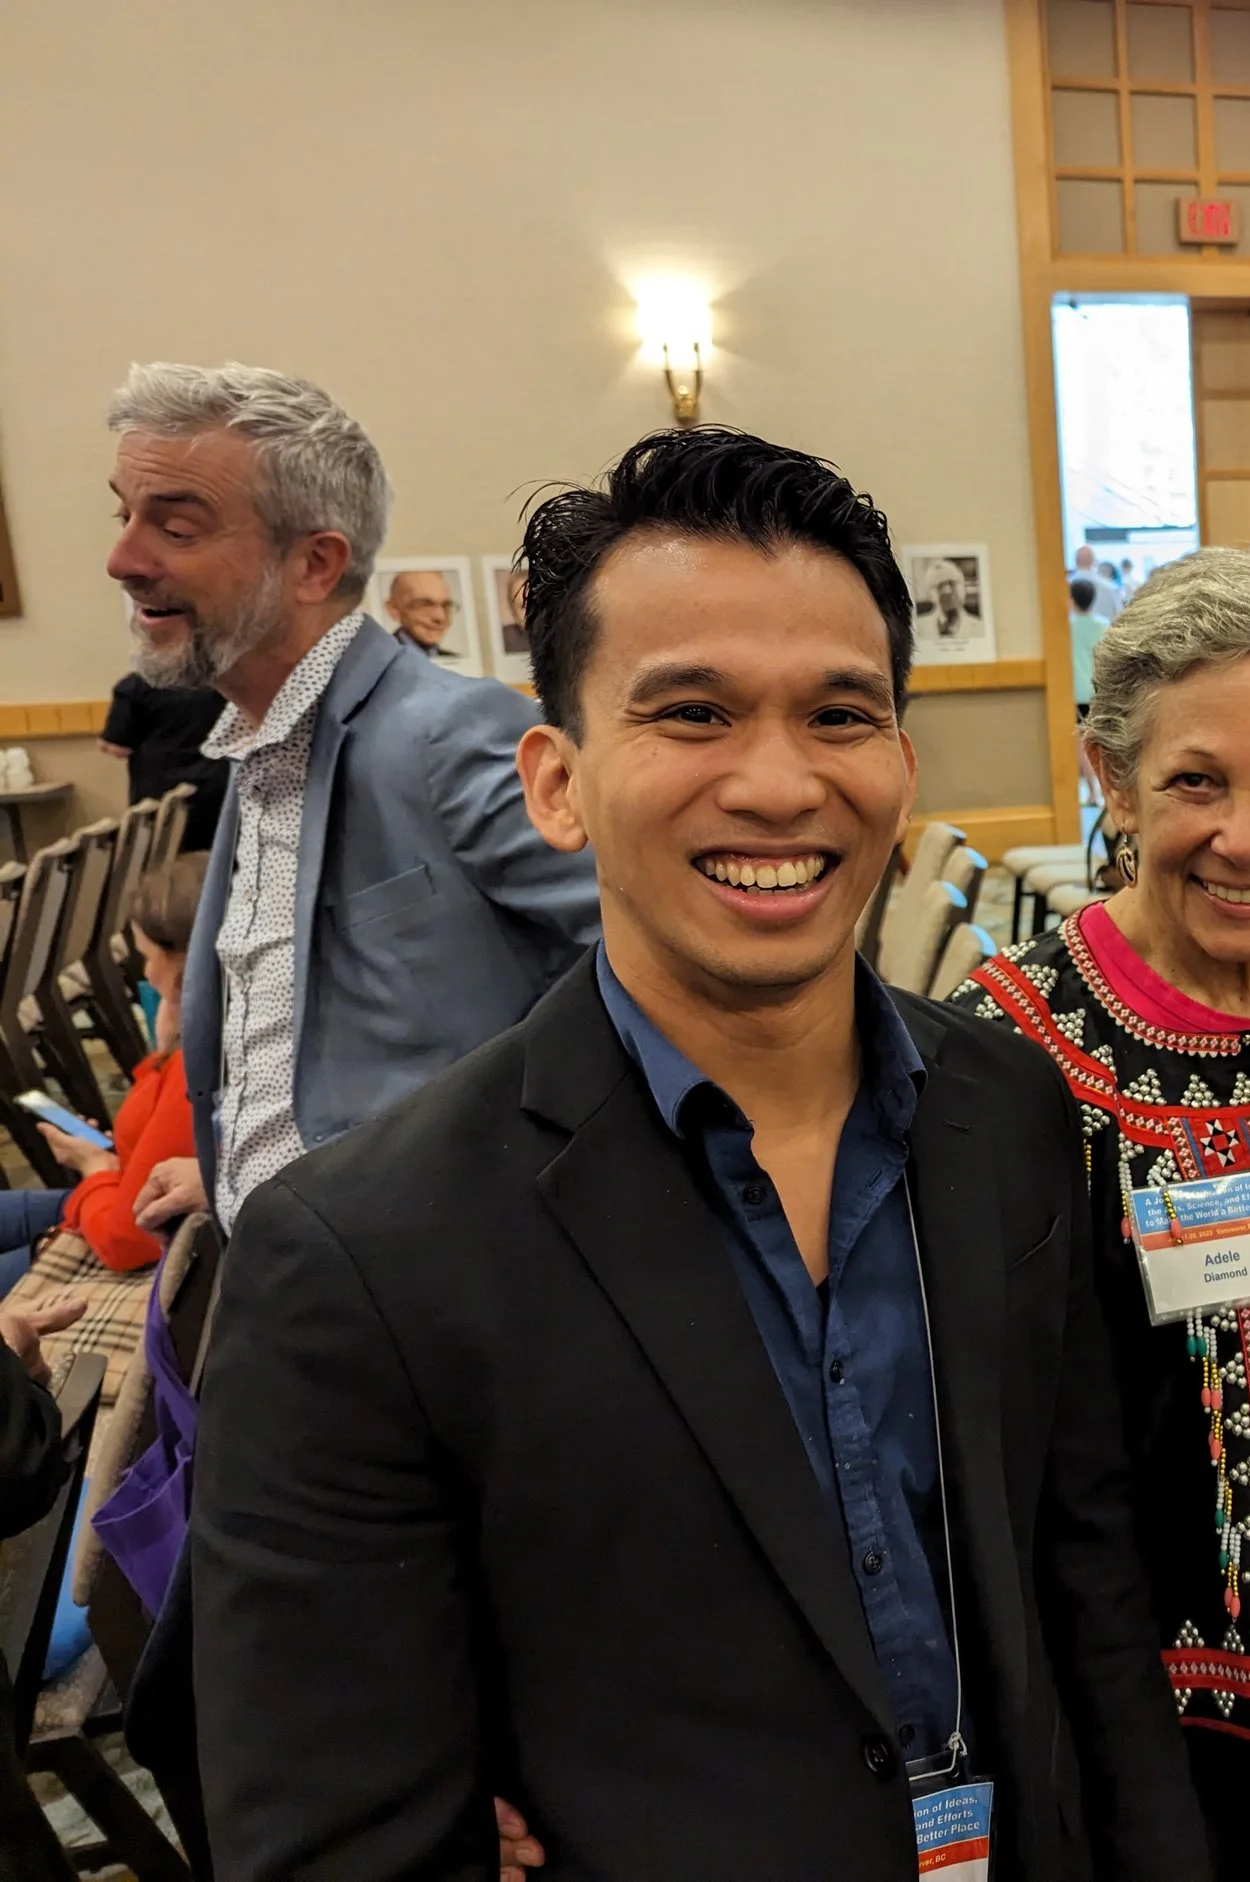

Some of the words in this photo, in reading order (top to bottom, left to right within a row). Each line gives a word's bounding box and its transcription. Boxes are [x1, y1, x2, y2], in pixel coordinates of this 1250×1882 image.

[1234, 1183, 1243, 1191] of
[1148, 1208, 1162, 1216] the
[1186, 1199, 1223, 1210] Science,
[1224, 1194, 1240, 1205] and
[1145, 1220, 1155, 1228] to
[1180, 1213, 1194, 1222] the
[1195, 1208, 1219, 1219] World
[1204, 1250, 1240, 1266] Adele
[1204, 1267, 1248, 1283] Diamond
[932, 1802, 942, 1811] of
[945, 1796, 978, 1809] Ideas,
[916, 1818, 935, 1831] and
[937, 1810, 973, 1825] Efforts
[916, 1828, 949, 1845] Better
[951, 1821, 980, 1835] Place
[935, 1853, 946, 1863] BC
